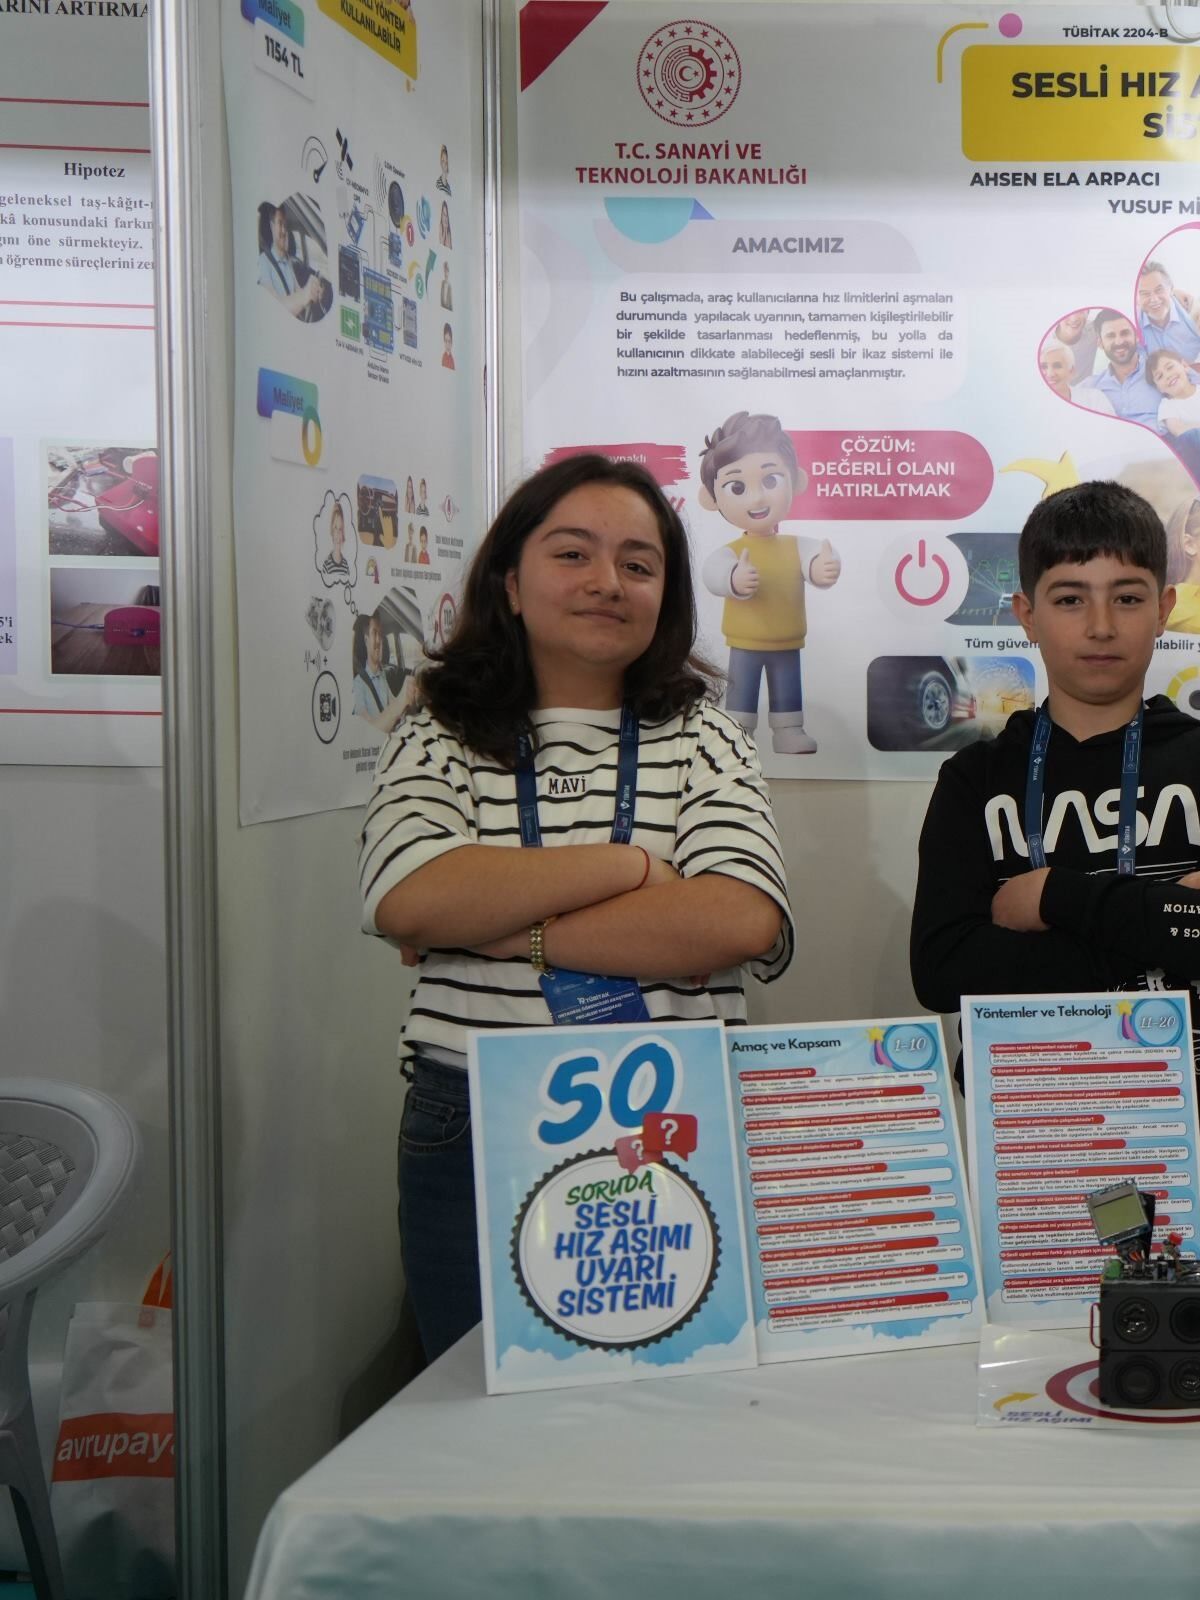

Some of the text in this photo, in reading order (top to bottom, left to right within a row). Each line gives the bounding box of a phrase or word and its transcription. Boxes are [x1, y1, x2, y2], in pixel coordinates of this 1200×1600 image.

[258, 0, 291, 29] Maliyet
[341, 0, 401, 53] KULLANILABİLİR
[1062, 25, 1169, 38] TÜBİTAK 2204-B
[264, 35, 304, 78] 1154 TL
[1012, 63, 1107, 99] SESLİ
[1121, 71, 1180, 98] HIZ
[615, 140, 761, 160] T.C. SANAYİ VE
[64, 162, 125, 180] Hipotez
[575, 164, 806, 185] TEKNOLOJİ BAKANLIĞI
[970, 172, 1159, 187] AHSEN ELA ARPACI
[1108, 199, 1172, 215] YUSUF
[23, 214, 108, 228] konusundaki
[28, 235, 143, 251] öne sürmekteyiz.
[732, 236, 844, 254] AMACIMIZ
[6, 254, 134, 270] öğrenme süreçlerini
[621, 292, 953, 305] Bu çalışmada, araç kullanıcılarına hız limitlerini aşmaları
[616, 310, 953, 324] durumunda yapılacak uyarının, tamamen kişileştirilebilir
[617, 329, 952, 343] bir şekilde tasarlanması hedeflenmiş, bu yolla da
[617, 348, 953, 361] kullanıcının dikkate alabileceği sesli bir ikaz sistemi ile
[617, 366, 905, 380] hızını azaltmasının sağlanabilmesi amaçlanmıştır.
[841, 435, 915, 456] ÇÖZÜM:
[812, 457, 956, 476] DEĞERLİ OLANI
[817, 482, 952, 497] HATIRLATMAK
[965, 638, 993, 649] Tüm
[549, 775, 586, 795] MAVİ
[1170, 927, 1179, 937] &
[974, 1005, 1176, 1029] Yöntemler ve Teknoloji 11-20
[731, 1041, 769, 1055] Amaç
[771, 1042, 786, 1050] ve
[788, 1038, 841, 1051] Kapsam
[538, 1042, 675, 1145] 50
[565, 1170, 656, 1206] SORUDA
[575, 1194, 658, 1230] SESLİ
[554, 1223, 693, 1261] HIZ AŞIMI
[576, 1254, 665, 1287] UYARI
